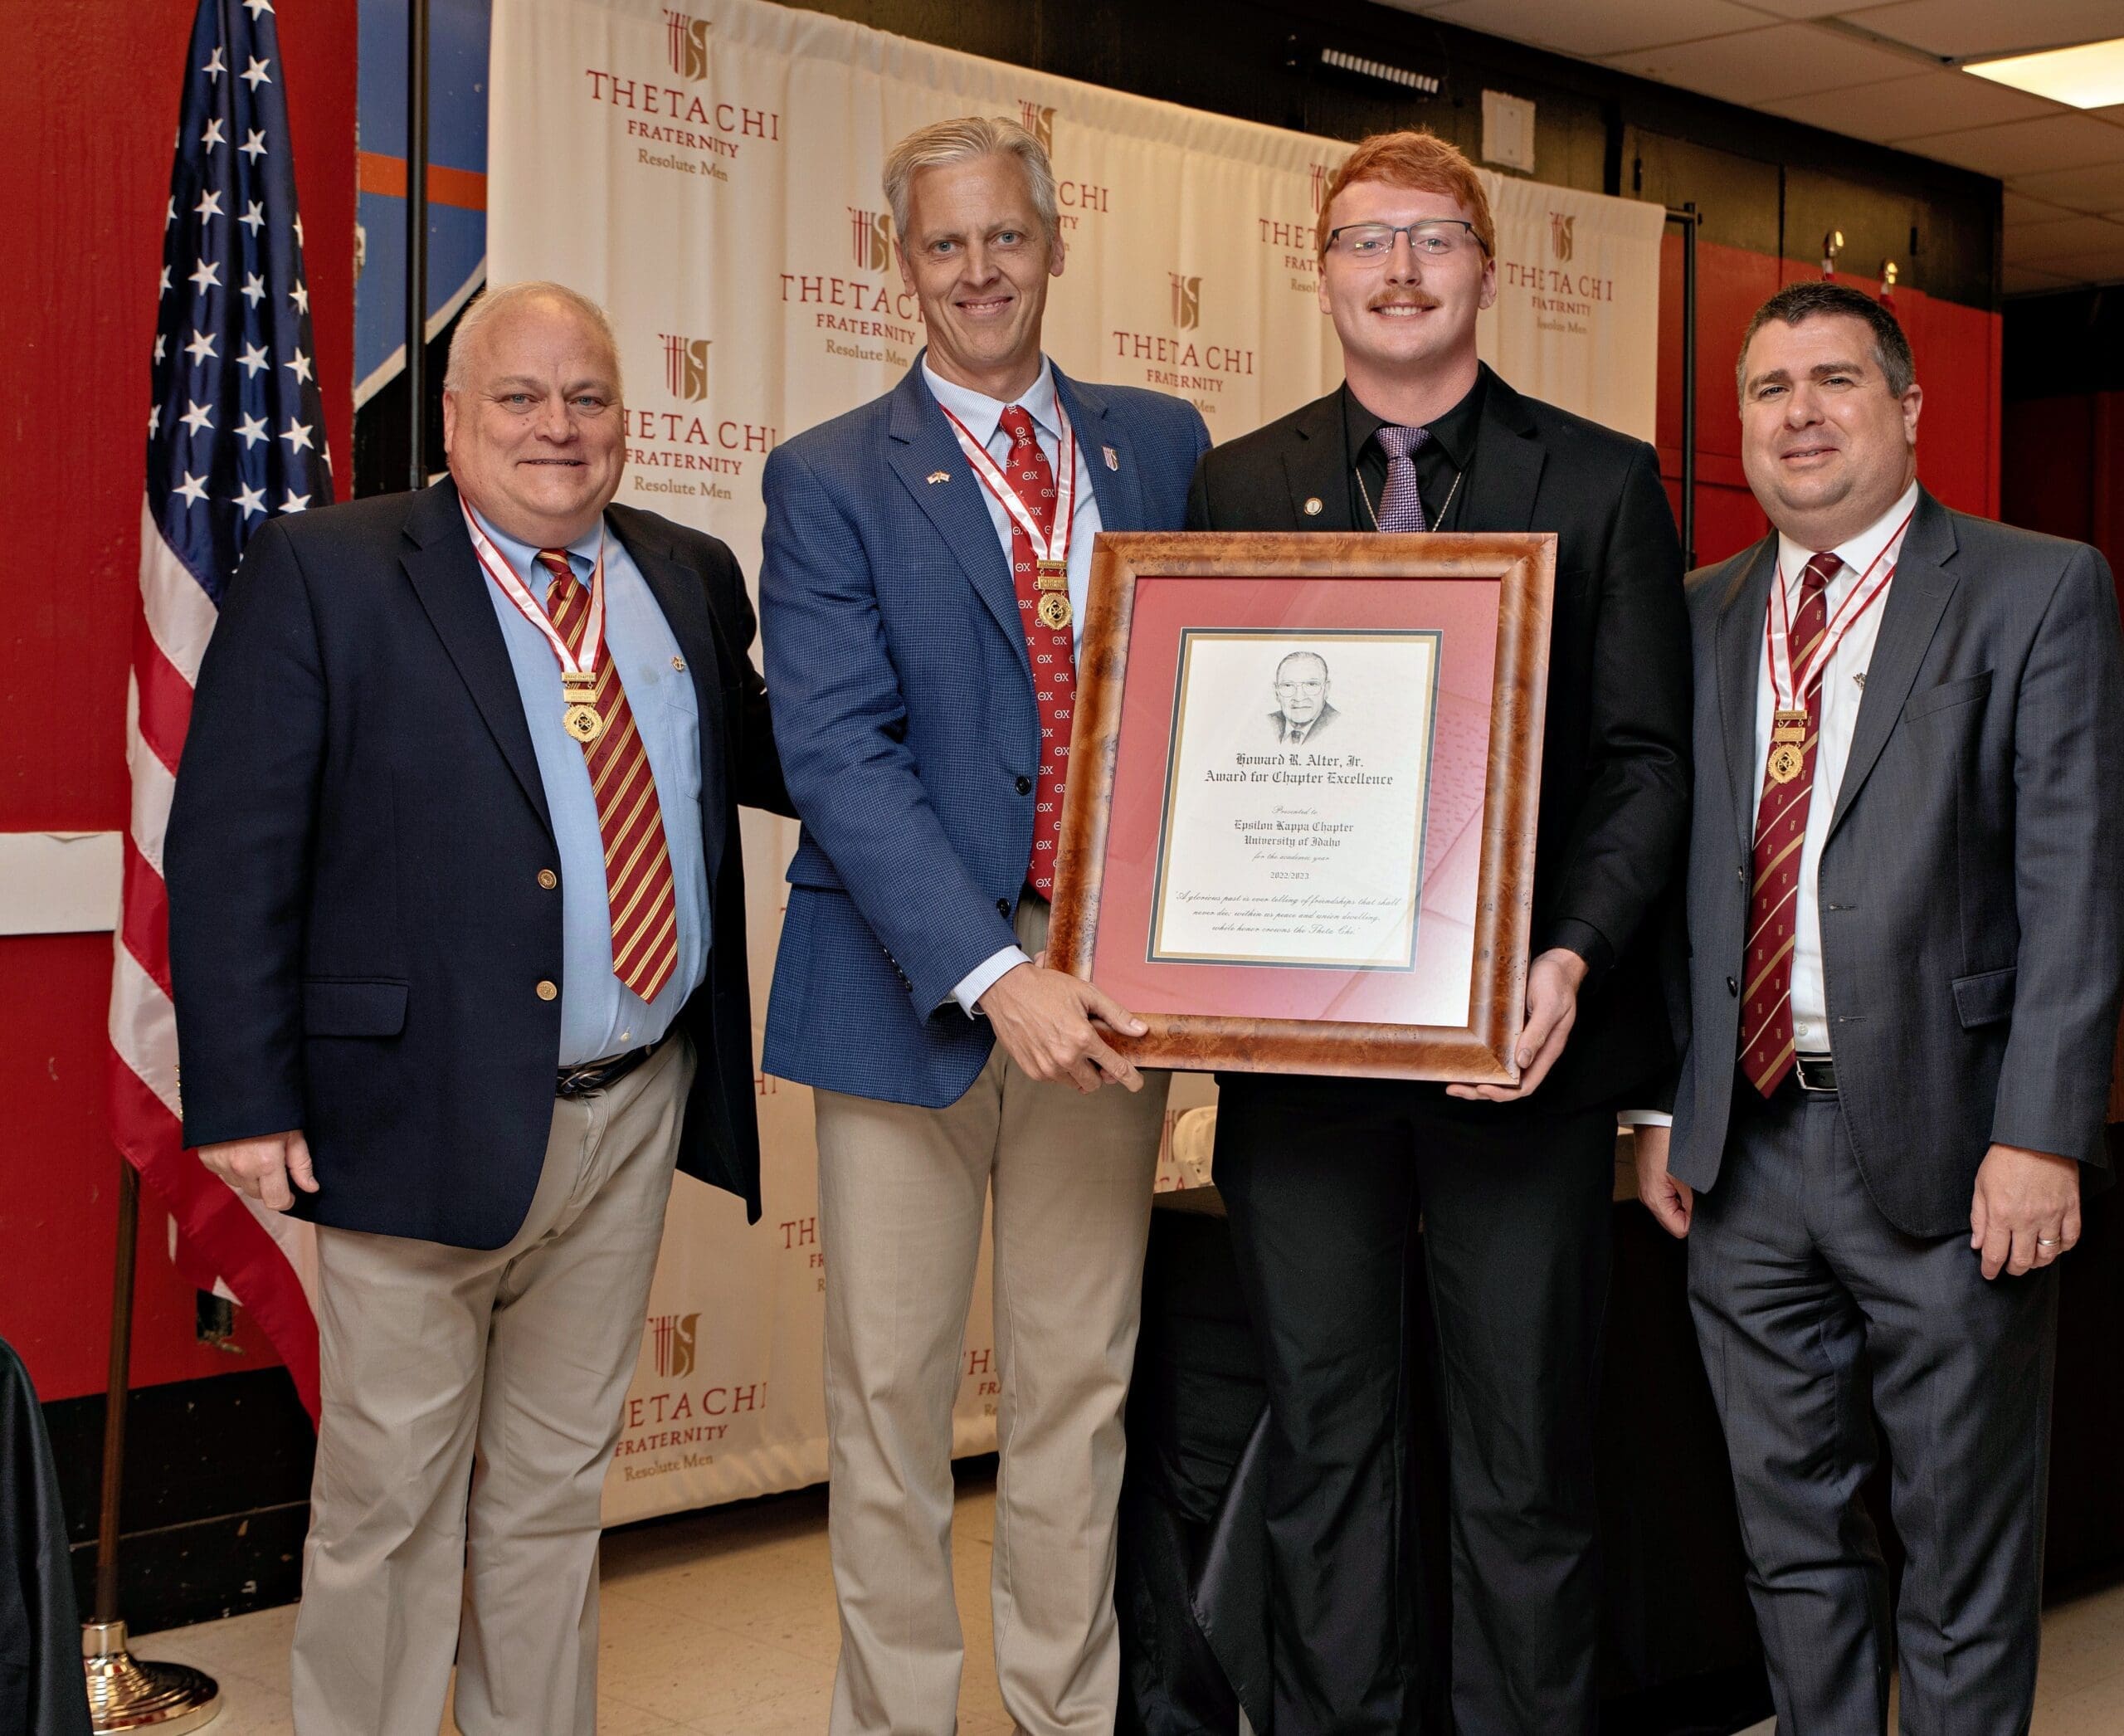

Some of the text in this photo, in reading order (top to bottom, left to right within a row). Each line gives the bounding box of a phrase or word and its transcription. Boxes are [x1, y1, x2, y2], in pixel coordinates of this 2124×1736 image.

[627, 119, 739, 158] FRATERNITY
[638, 148, 728, 182] Resolute Men
[816, 314, 916, 345] FRATERNITY
[825, 338, 909, 368] Resolute Men
[1146, 368, 1224, 393] FRATERNITY
[624, 448, 743, 475] FRATERNITY
[634, 475, 732, 500] Resolute Men
[1235, 753, 1285, 767] Howard
[1289, 753, 1302, 766] R.
[1306, 754, 1343, 768] Alter,
[1205, 769, 1394, 786] Award for Chapter Excellence
[1271, 805, 1312, 815] Presented
[1234, 819, 1354, 835] Epsilon Kappa Chapter
[1244, 835, 1341, 848] University of Idaho
[1251, 851, 1265, 862] for
[1269, 871, 1309, 880] 2022/2023
[1186, 892, 1220, 903] glorious
[1220, 895, 1241, 905] past
[1309, 895, 1356, 908] friendships
[1357, 896, 1376, 905] that
[1377, 897, 1401, 905] shall
[1308, 924, 1334, 934] Theta
[614, 1424, 728, 1457] FRATERNITY
[625, 1453, 714, 1482] Resolute Men
